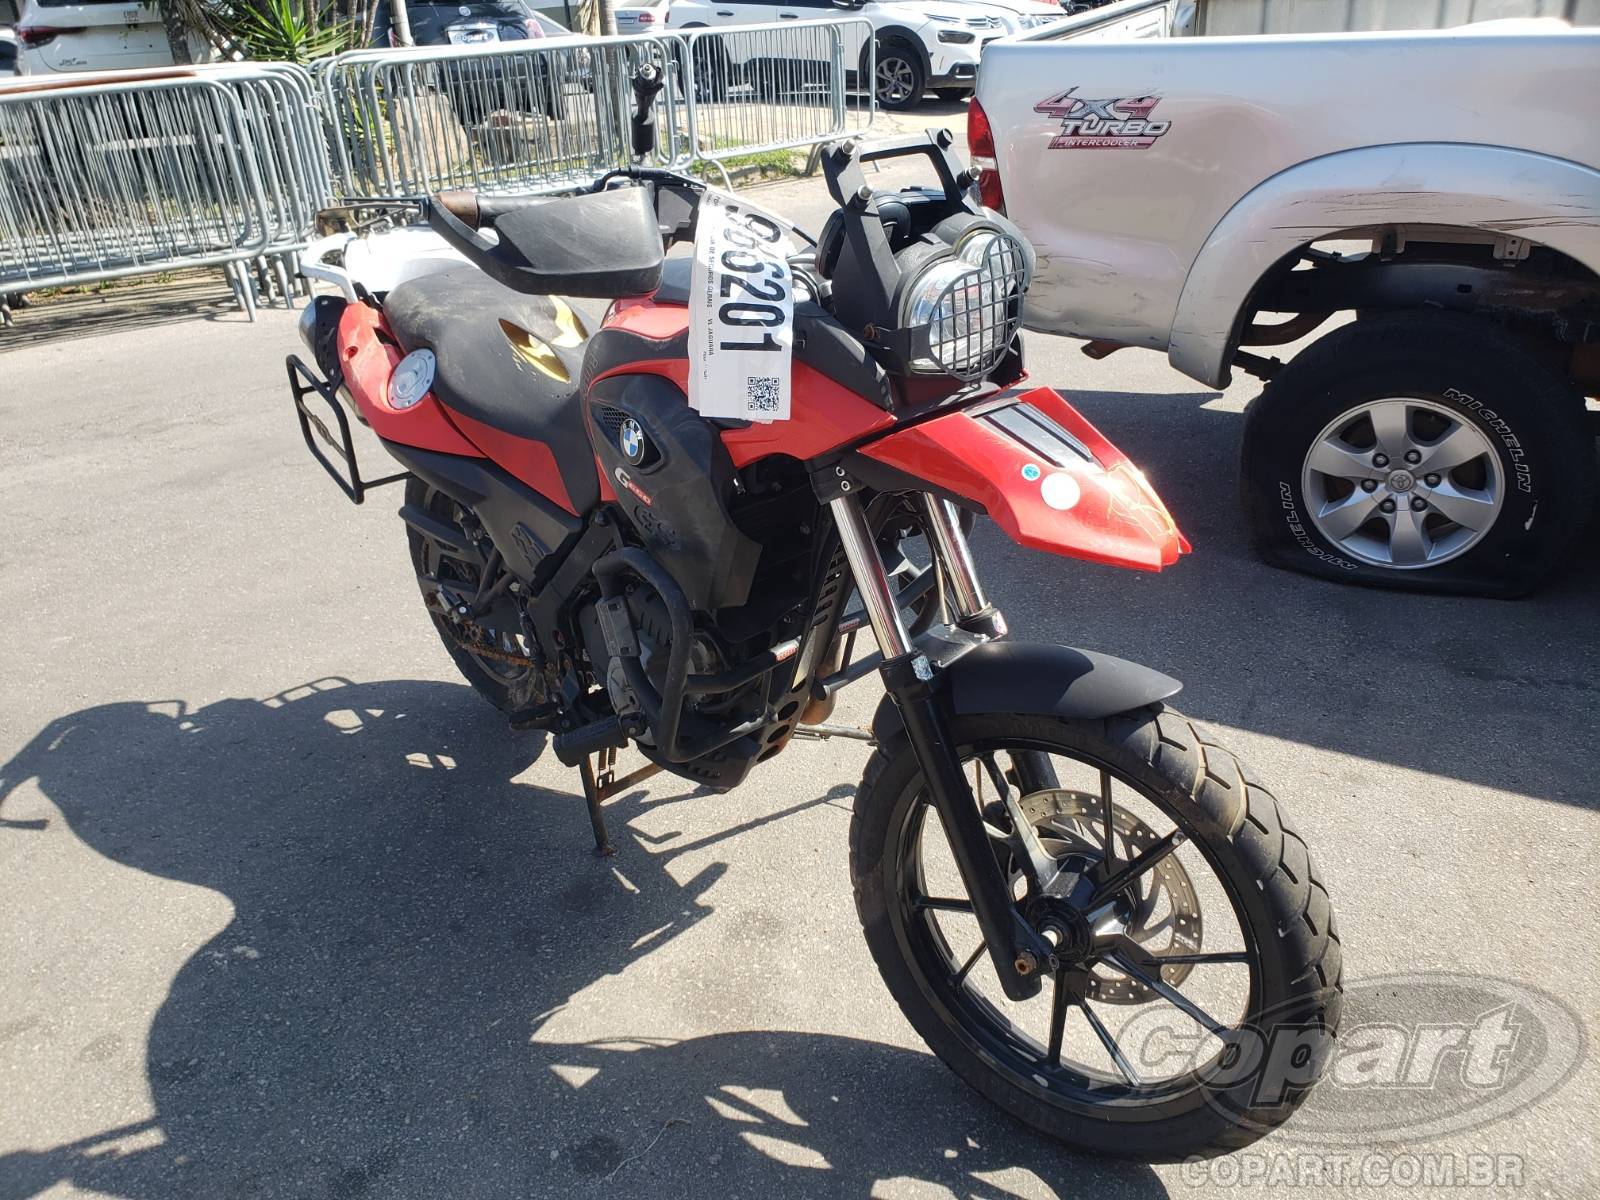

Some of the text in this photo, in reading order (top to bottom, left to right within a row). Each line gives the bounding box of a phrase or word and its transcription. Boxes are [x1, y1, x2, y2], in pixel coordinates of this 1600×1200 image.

[1061, 117, 1172, 136] TURBO
[1064, 138, 1138, 147] INTERCOOLER
[1442, 388, 1531, 493] MICHELIN
[1280, 482, 1358, 570] MICHELIN
